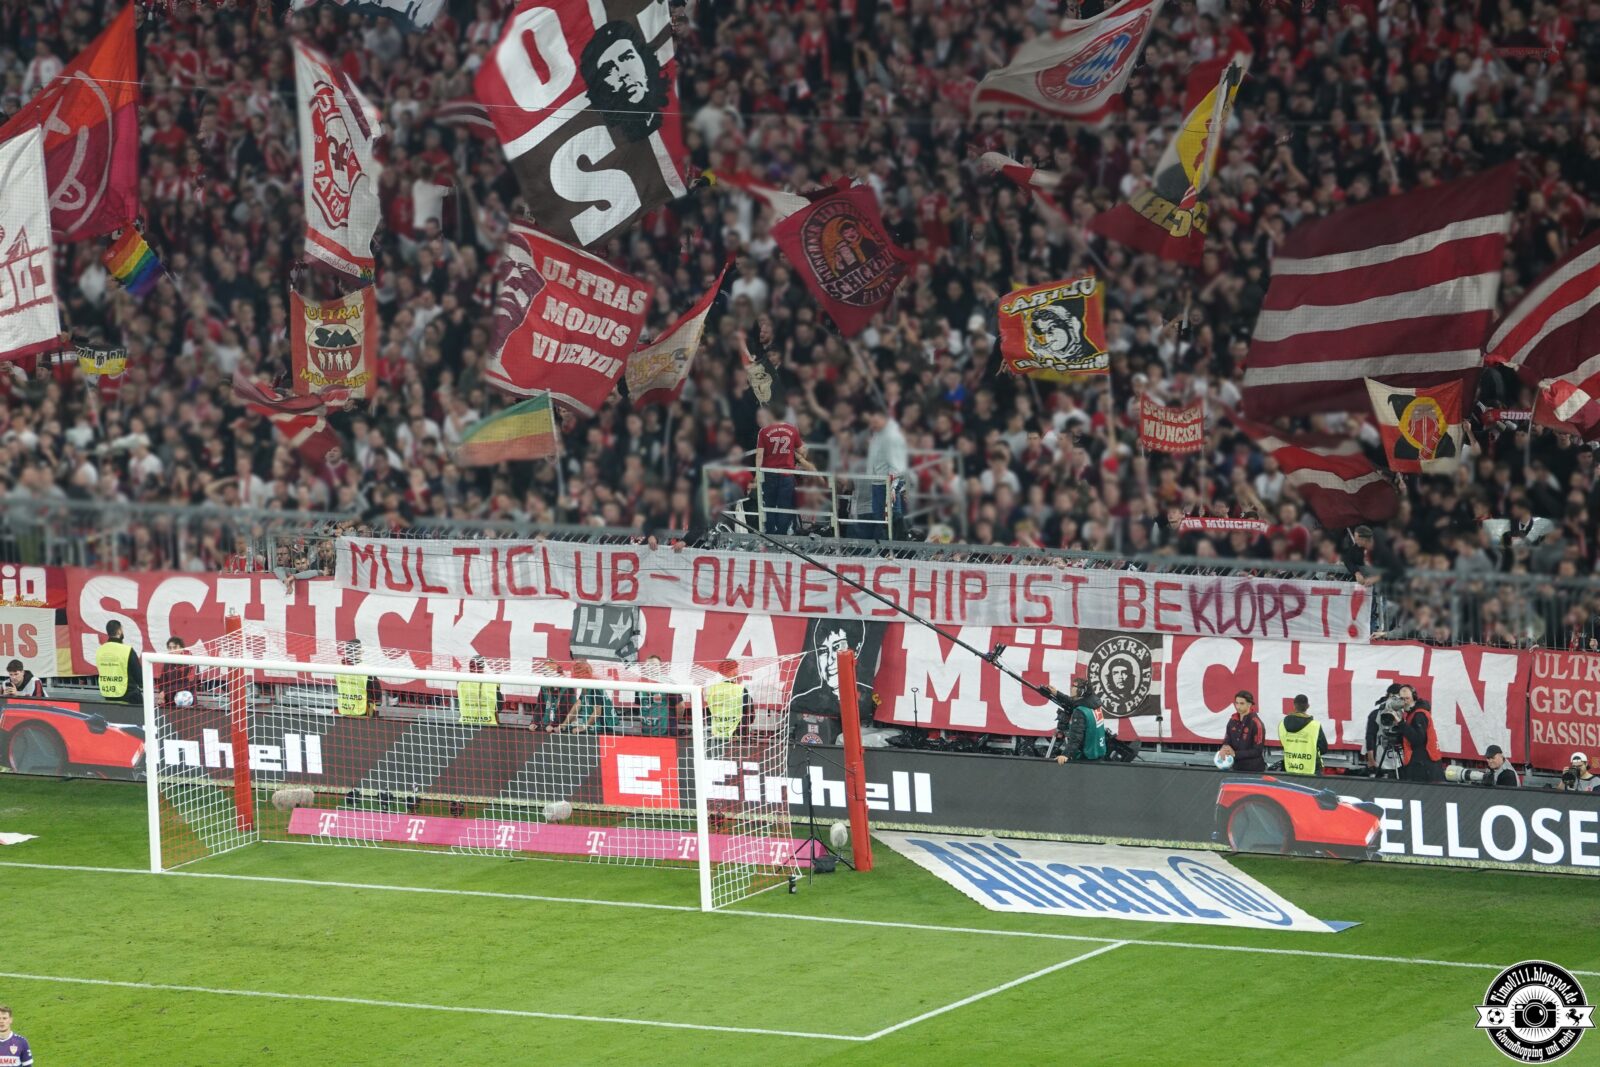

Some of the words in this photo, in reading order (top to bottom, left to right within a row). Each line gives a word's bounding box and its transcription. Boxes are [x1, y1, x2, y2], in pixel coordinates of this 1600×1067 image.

[542, 256, 647, 315] ULTRAS
[541, 295, 631, 347] MODUS
[769, 436, 791, 454] 72
[1205, 518, 1269, 533] MÜNCHEN
[1009, 571, 1089, 626] IST
[1089, 662, 1121, 713] SANKT
[1124, 667, 1152, 712] PAULI
[702, 759, 933, 813] Einhell
[906, 838, 1231, 919] Allianz
